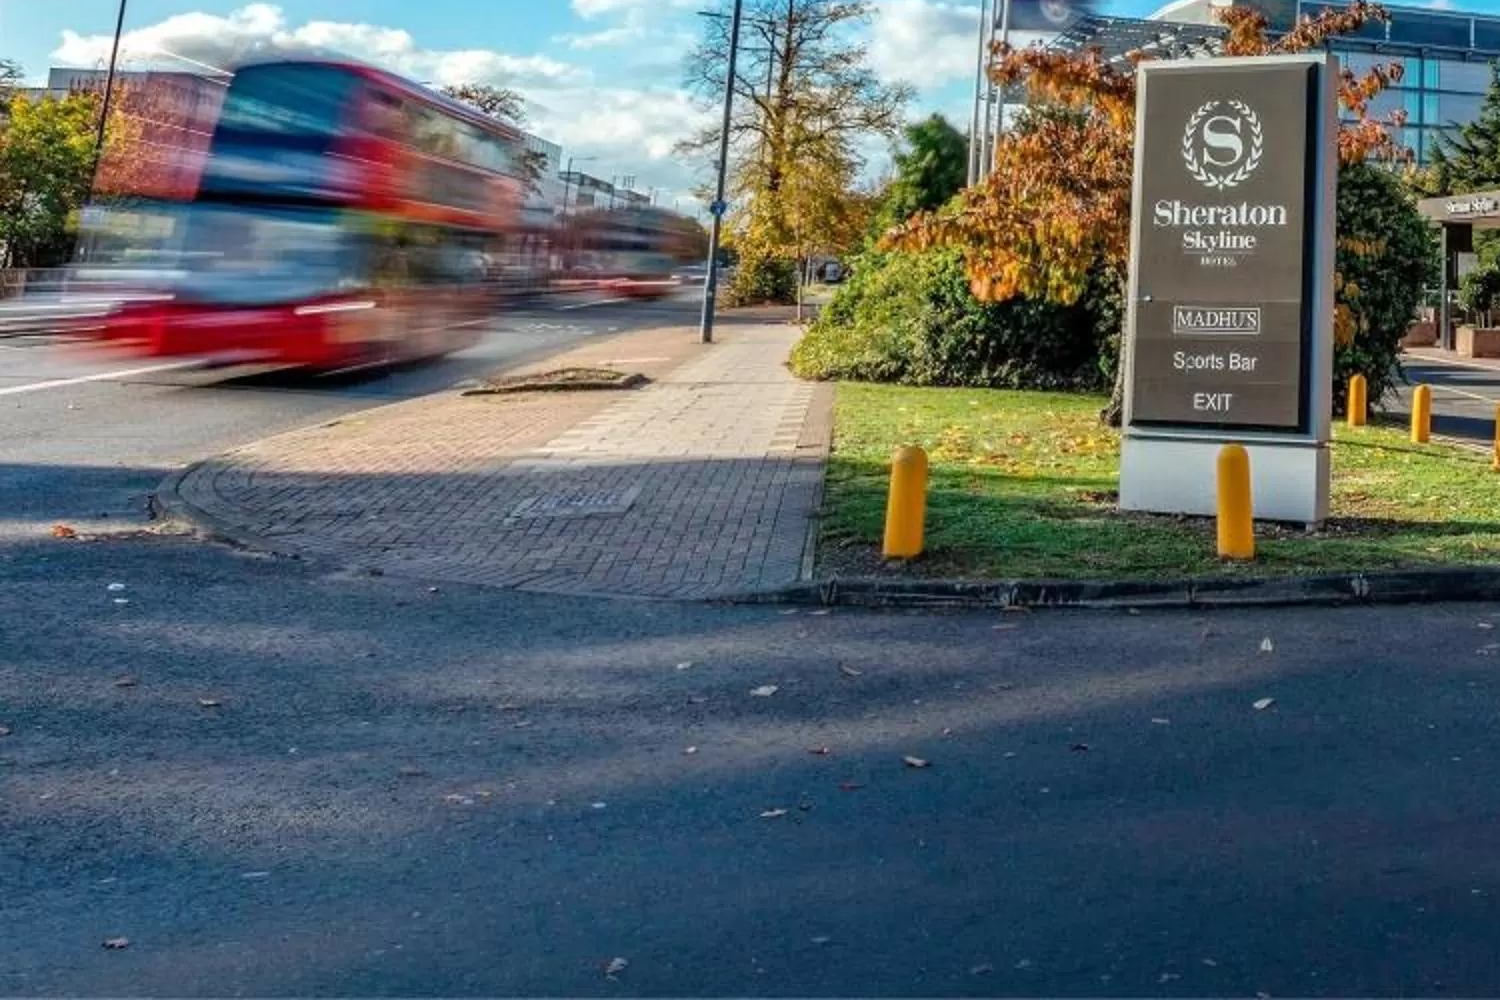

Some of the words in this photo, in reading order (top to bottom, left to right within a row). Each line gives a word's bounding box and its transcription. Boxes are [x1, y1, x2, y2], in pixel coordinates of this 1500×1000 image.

[1203, 115, 1243, 167] S
[1153, 200, 1287, 227] Sheraton
[1183, 230, 1257, 253] Skyline
[1173, 351, 1225, 374] Sports
[1229, 353, 1258, 371] Bar
[1193, 393, 1233, 411] EXIT
